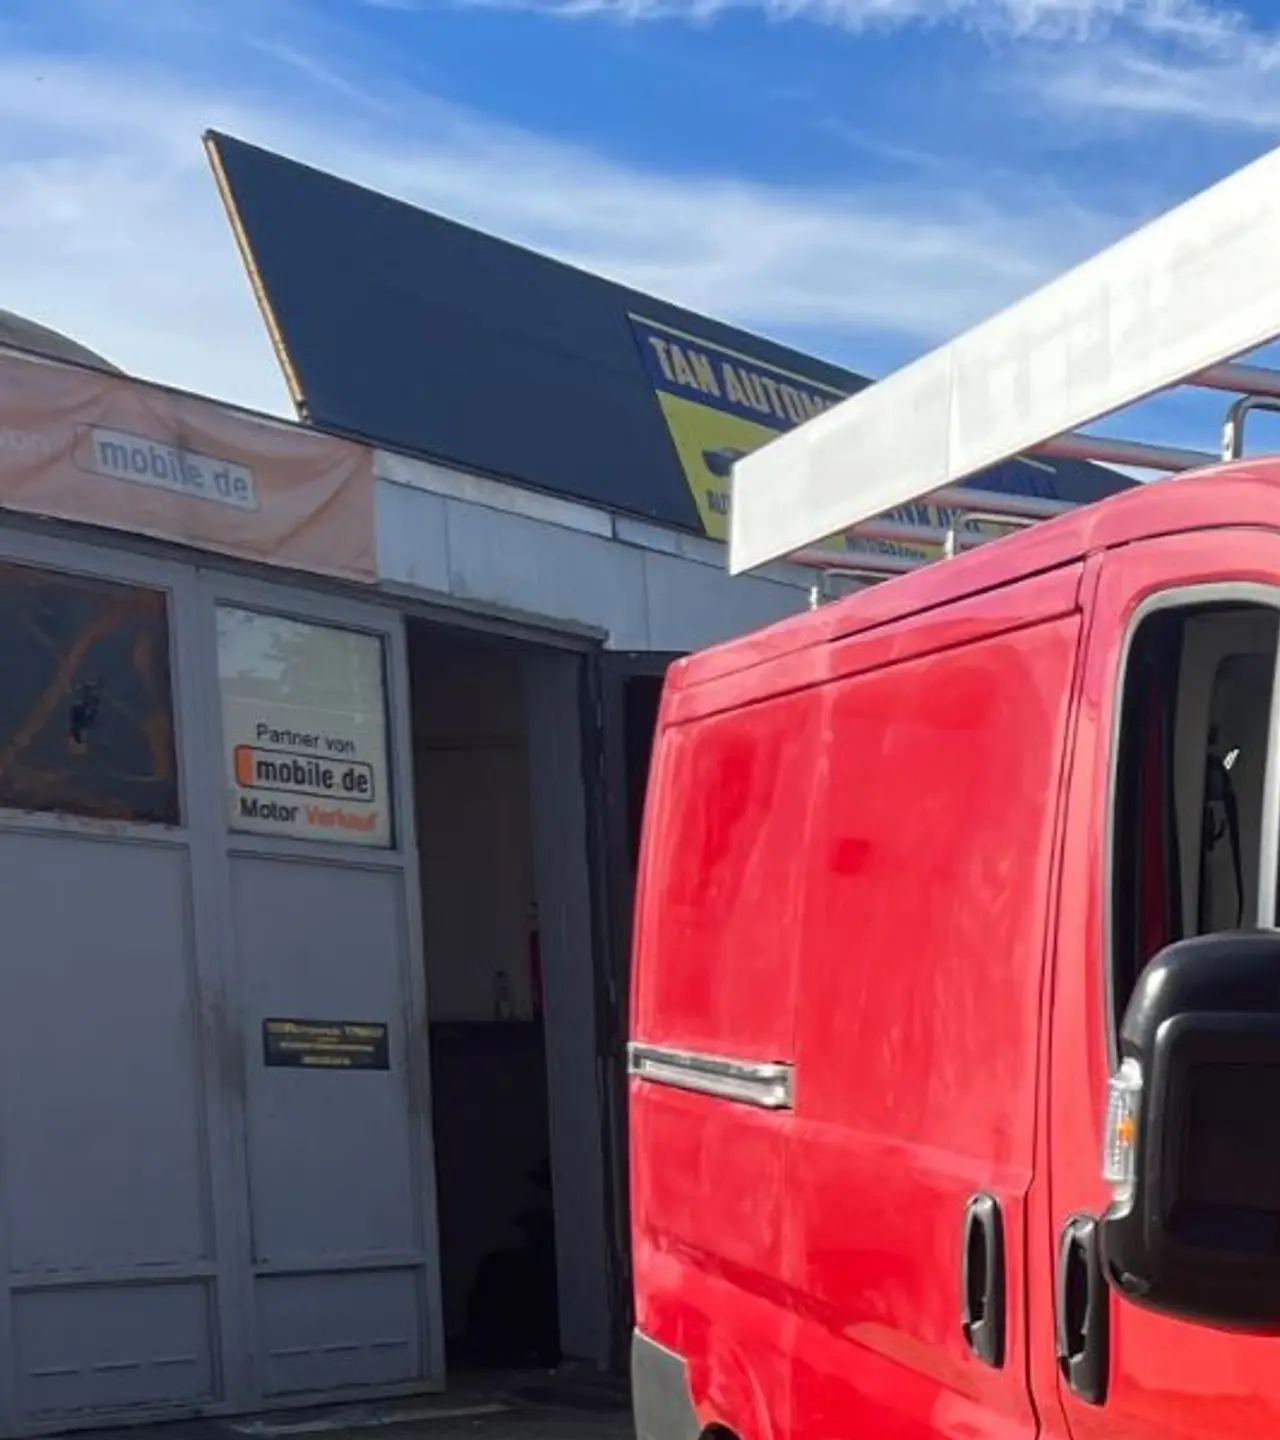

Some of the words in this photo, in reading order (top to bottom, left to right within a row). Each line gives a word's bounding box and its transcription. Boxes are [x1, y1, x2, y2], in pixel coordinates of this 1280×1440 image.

[648, 336, 721, 398] TAN
[97, 440, 250, 500] mobile.de
[256, 722, 320, 749] Partner
[325, 738, 356, 753] von
[256, 760, 370, 794] mobile.de
[239, 797, 299, 823] Motor
